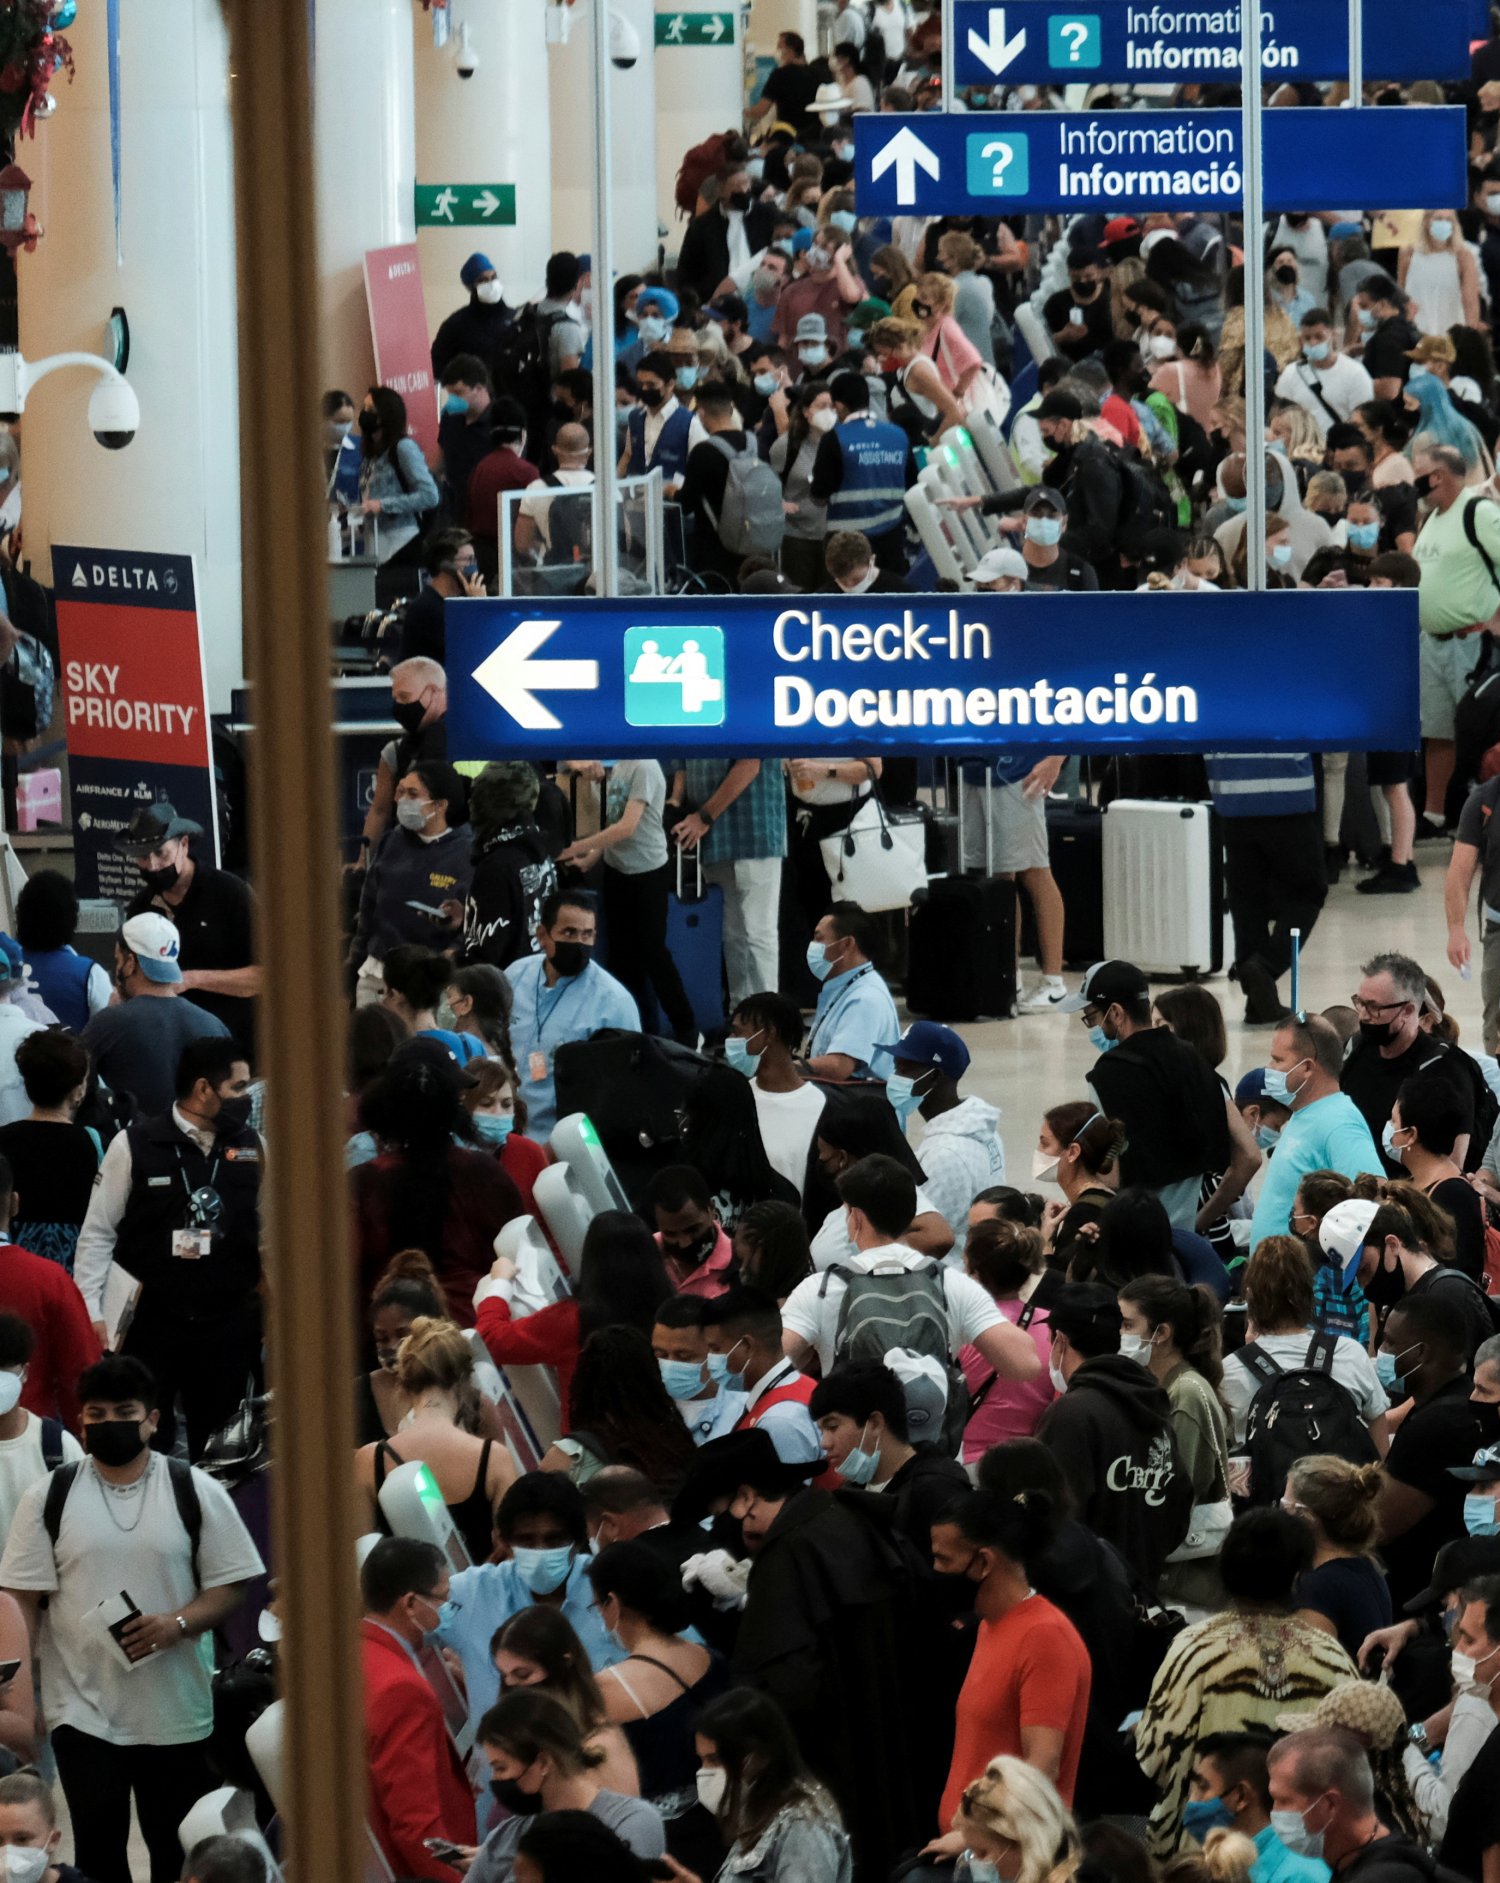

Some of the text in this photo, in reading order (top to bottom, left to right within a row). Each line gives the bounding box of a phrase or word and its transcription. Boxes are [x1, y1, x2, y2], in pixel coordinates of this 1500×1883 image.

[1126, 5, 1274, 34] Informatin
[1126, 39, 1298, 69] Informaón
[1060, 121, 1234, 155] Information
[1059, 161, 1243, 196] Informació
[407, 370, 429, 393] CABIN
[92, 565, 159, 592] DELTA
[772, 608, 992, 662] Check-In
[66, 660, 120, 695] SKY
[772, 672, 1199, 728] Documentación
[133, 789, 153, 800] KLM
